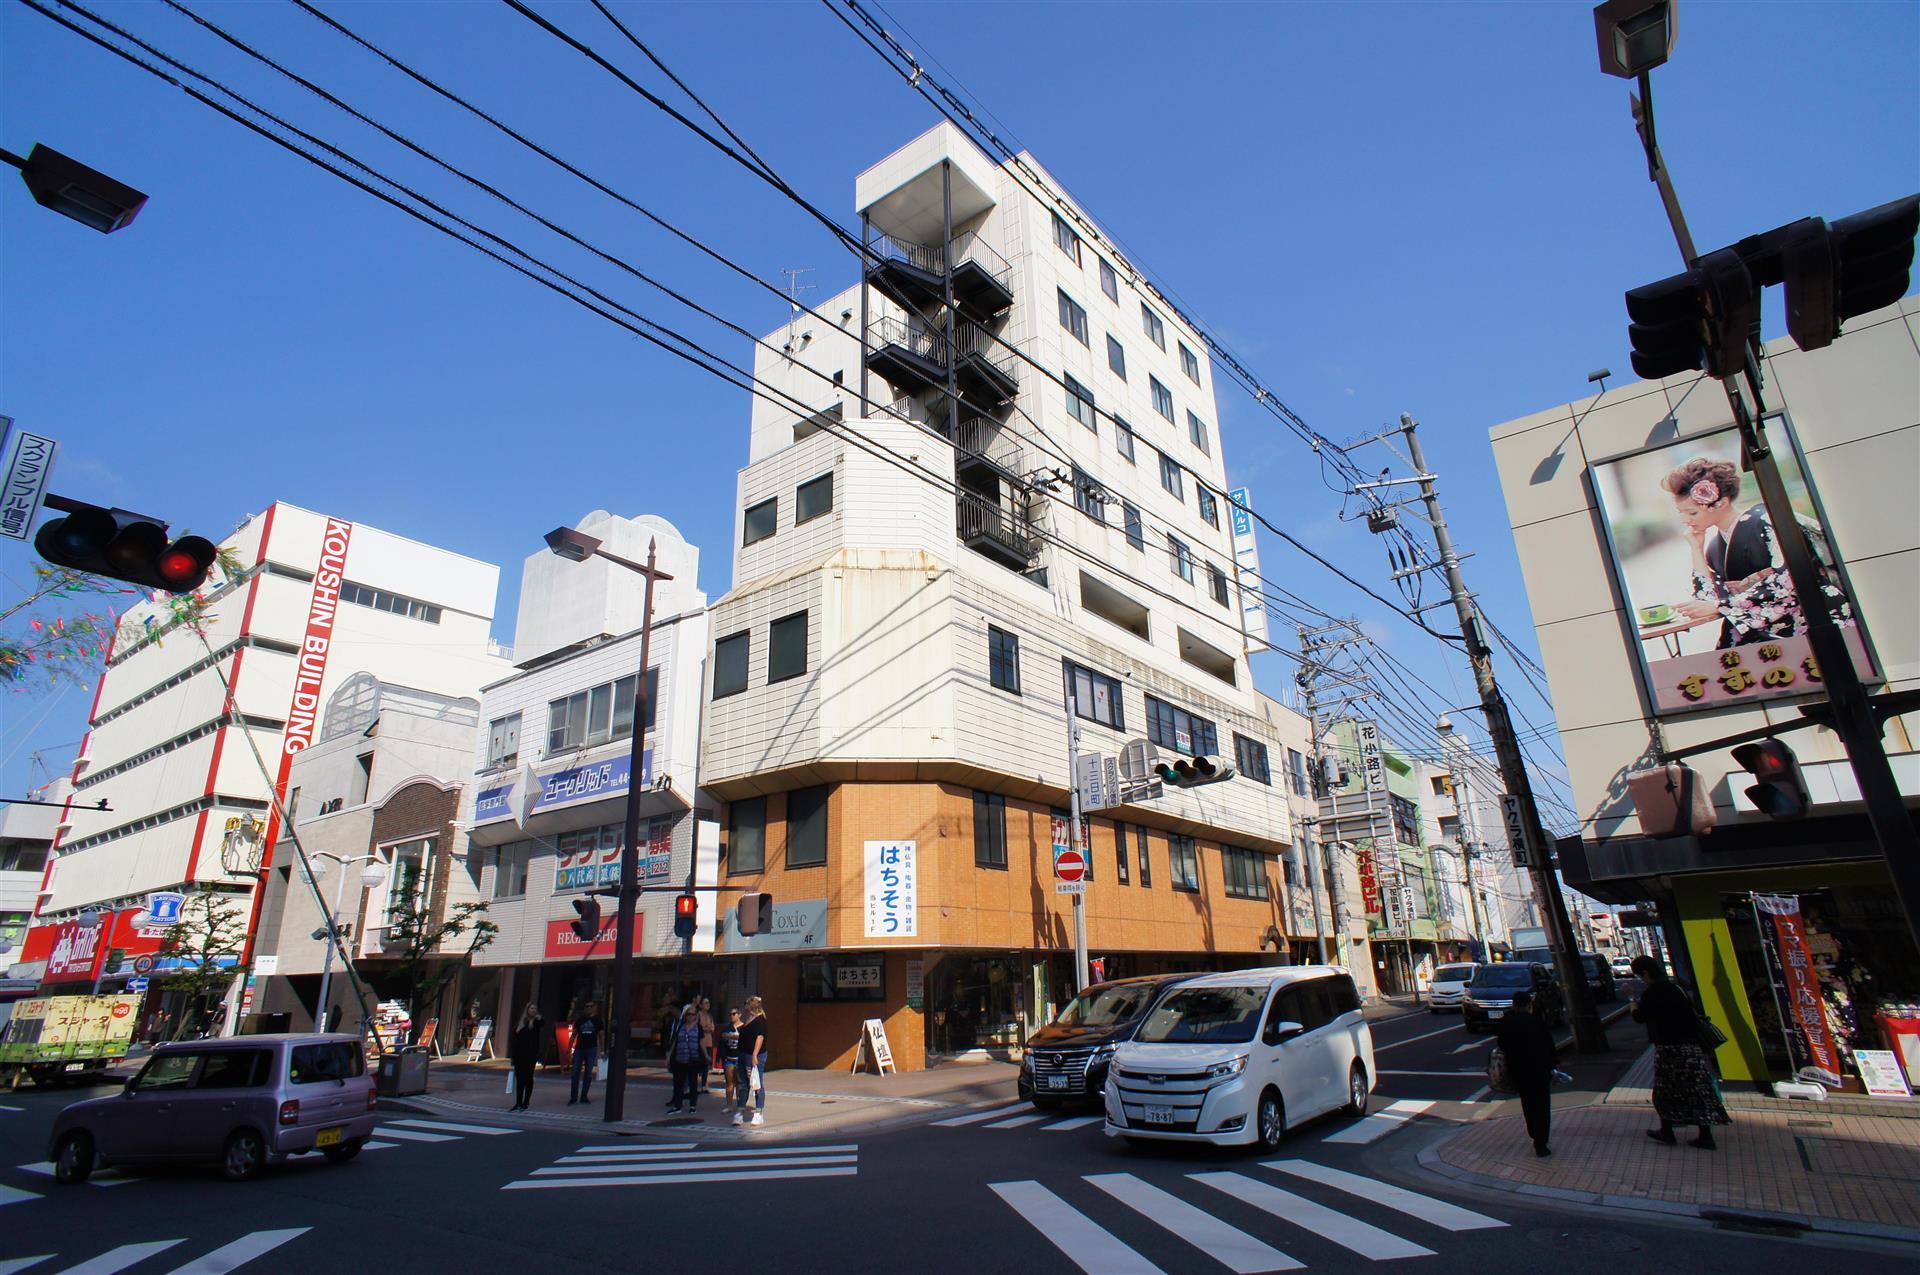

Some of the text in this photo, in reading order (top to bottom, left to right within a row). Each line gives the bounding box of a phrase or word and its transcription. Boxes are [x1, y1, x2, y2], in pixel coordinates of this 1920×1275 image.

[1, 438, 46, 535] スクランブル信号
[284, 519, 350, 755] KOUSHIN BUILDING
[1361, 725, 1382, 791] 花小路ビ
[544, 763, 613, 802] ユークリッド
[1088, 759, 1100, 805] 十三日町
[880, 846, 901, 933] はちそう
[804, 934, 814, 944] 4F
[138, 959, 150, 969] 40
[839, 967, 879, 981] はちそう
[58, 1014, 110, 1026] スジャータ
[1150, 1112, 1173, 1123] 78-87
